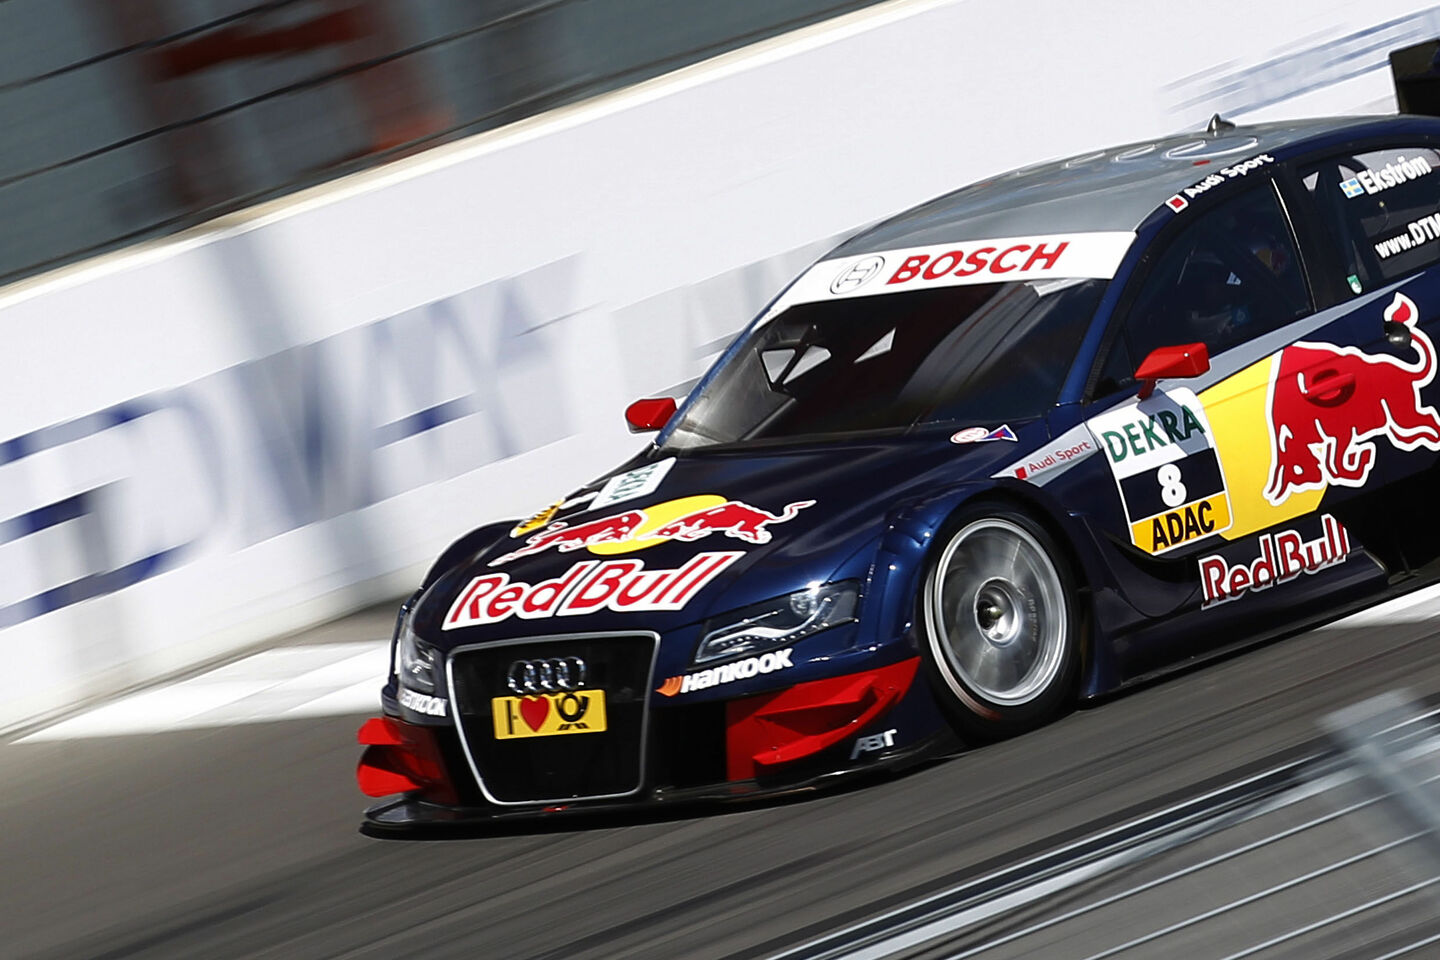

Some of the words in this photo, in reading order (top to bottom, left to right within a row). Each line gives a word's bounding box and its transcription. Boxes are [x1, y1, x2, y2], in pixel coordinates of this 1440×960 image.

[1184, 174, 1225, 198] Audi
[1220, 154, 1274, 176] Sport
[1357, 156, 1432, 195] Ekström
[886, 242, 1070, 285] BOSCH
[1101, 405, 1206, 464] DEKRA
[1028, 454, 1056, 473] Audi
[1055, 441, 1091, 461] Sport
[1157, 463, 1187, 508] 8
[1152, 500, 1215, 552] ADAC
[850, 729, 897, 760] ABT
